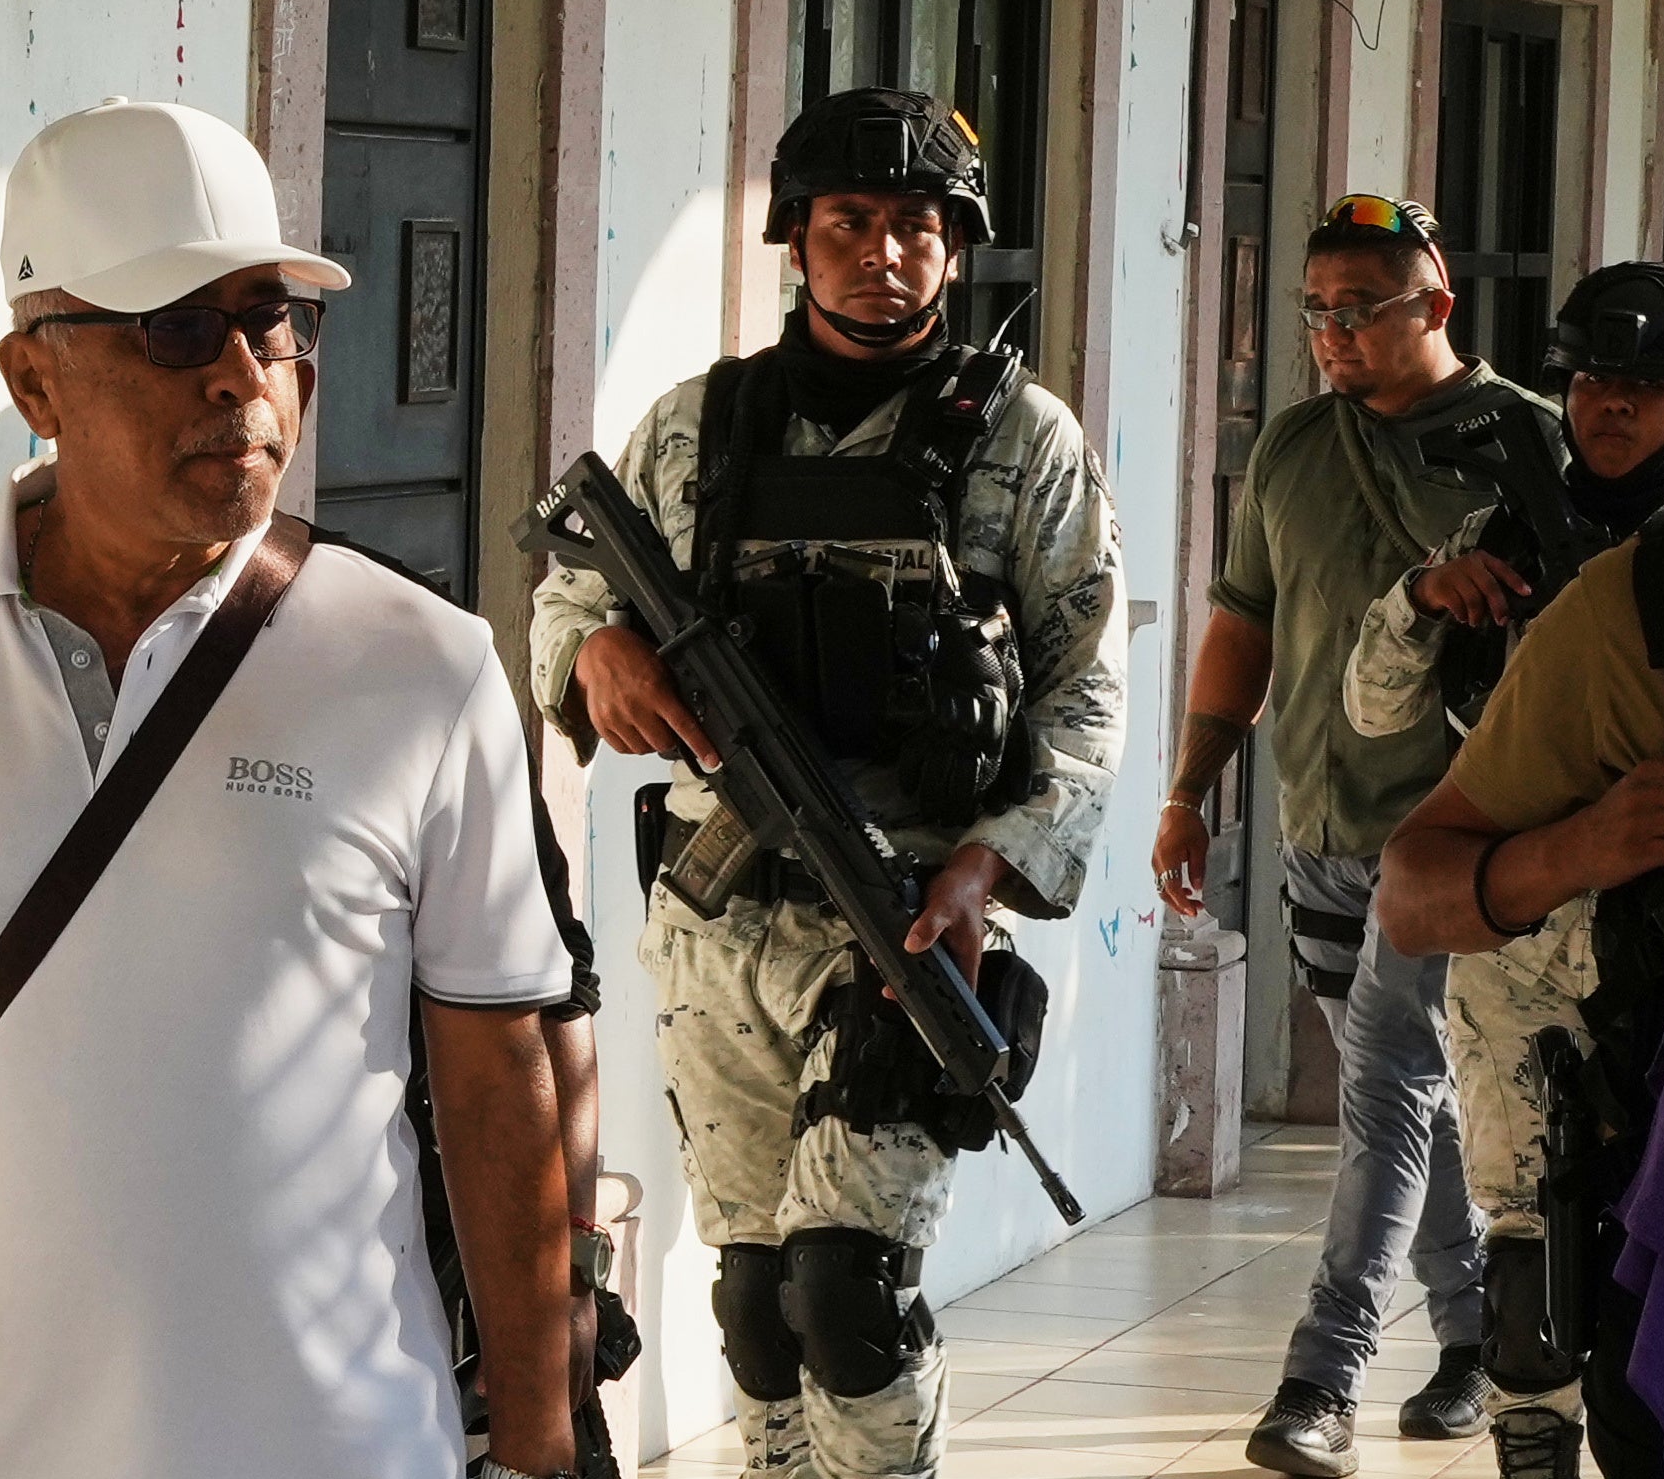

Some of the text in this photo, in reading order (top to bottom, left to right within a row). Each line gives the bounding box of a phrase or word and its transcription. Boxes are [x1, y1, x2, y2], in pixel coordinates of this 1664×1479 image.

[226, 756, 314, 789] BOSS
[225, 781, 313, 801] HUGO BOSS
